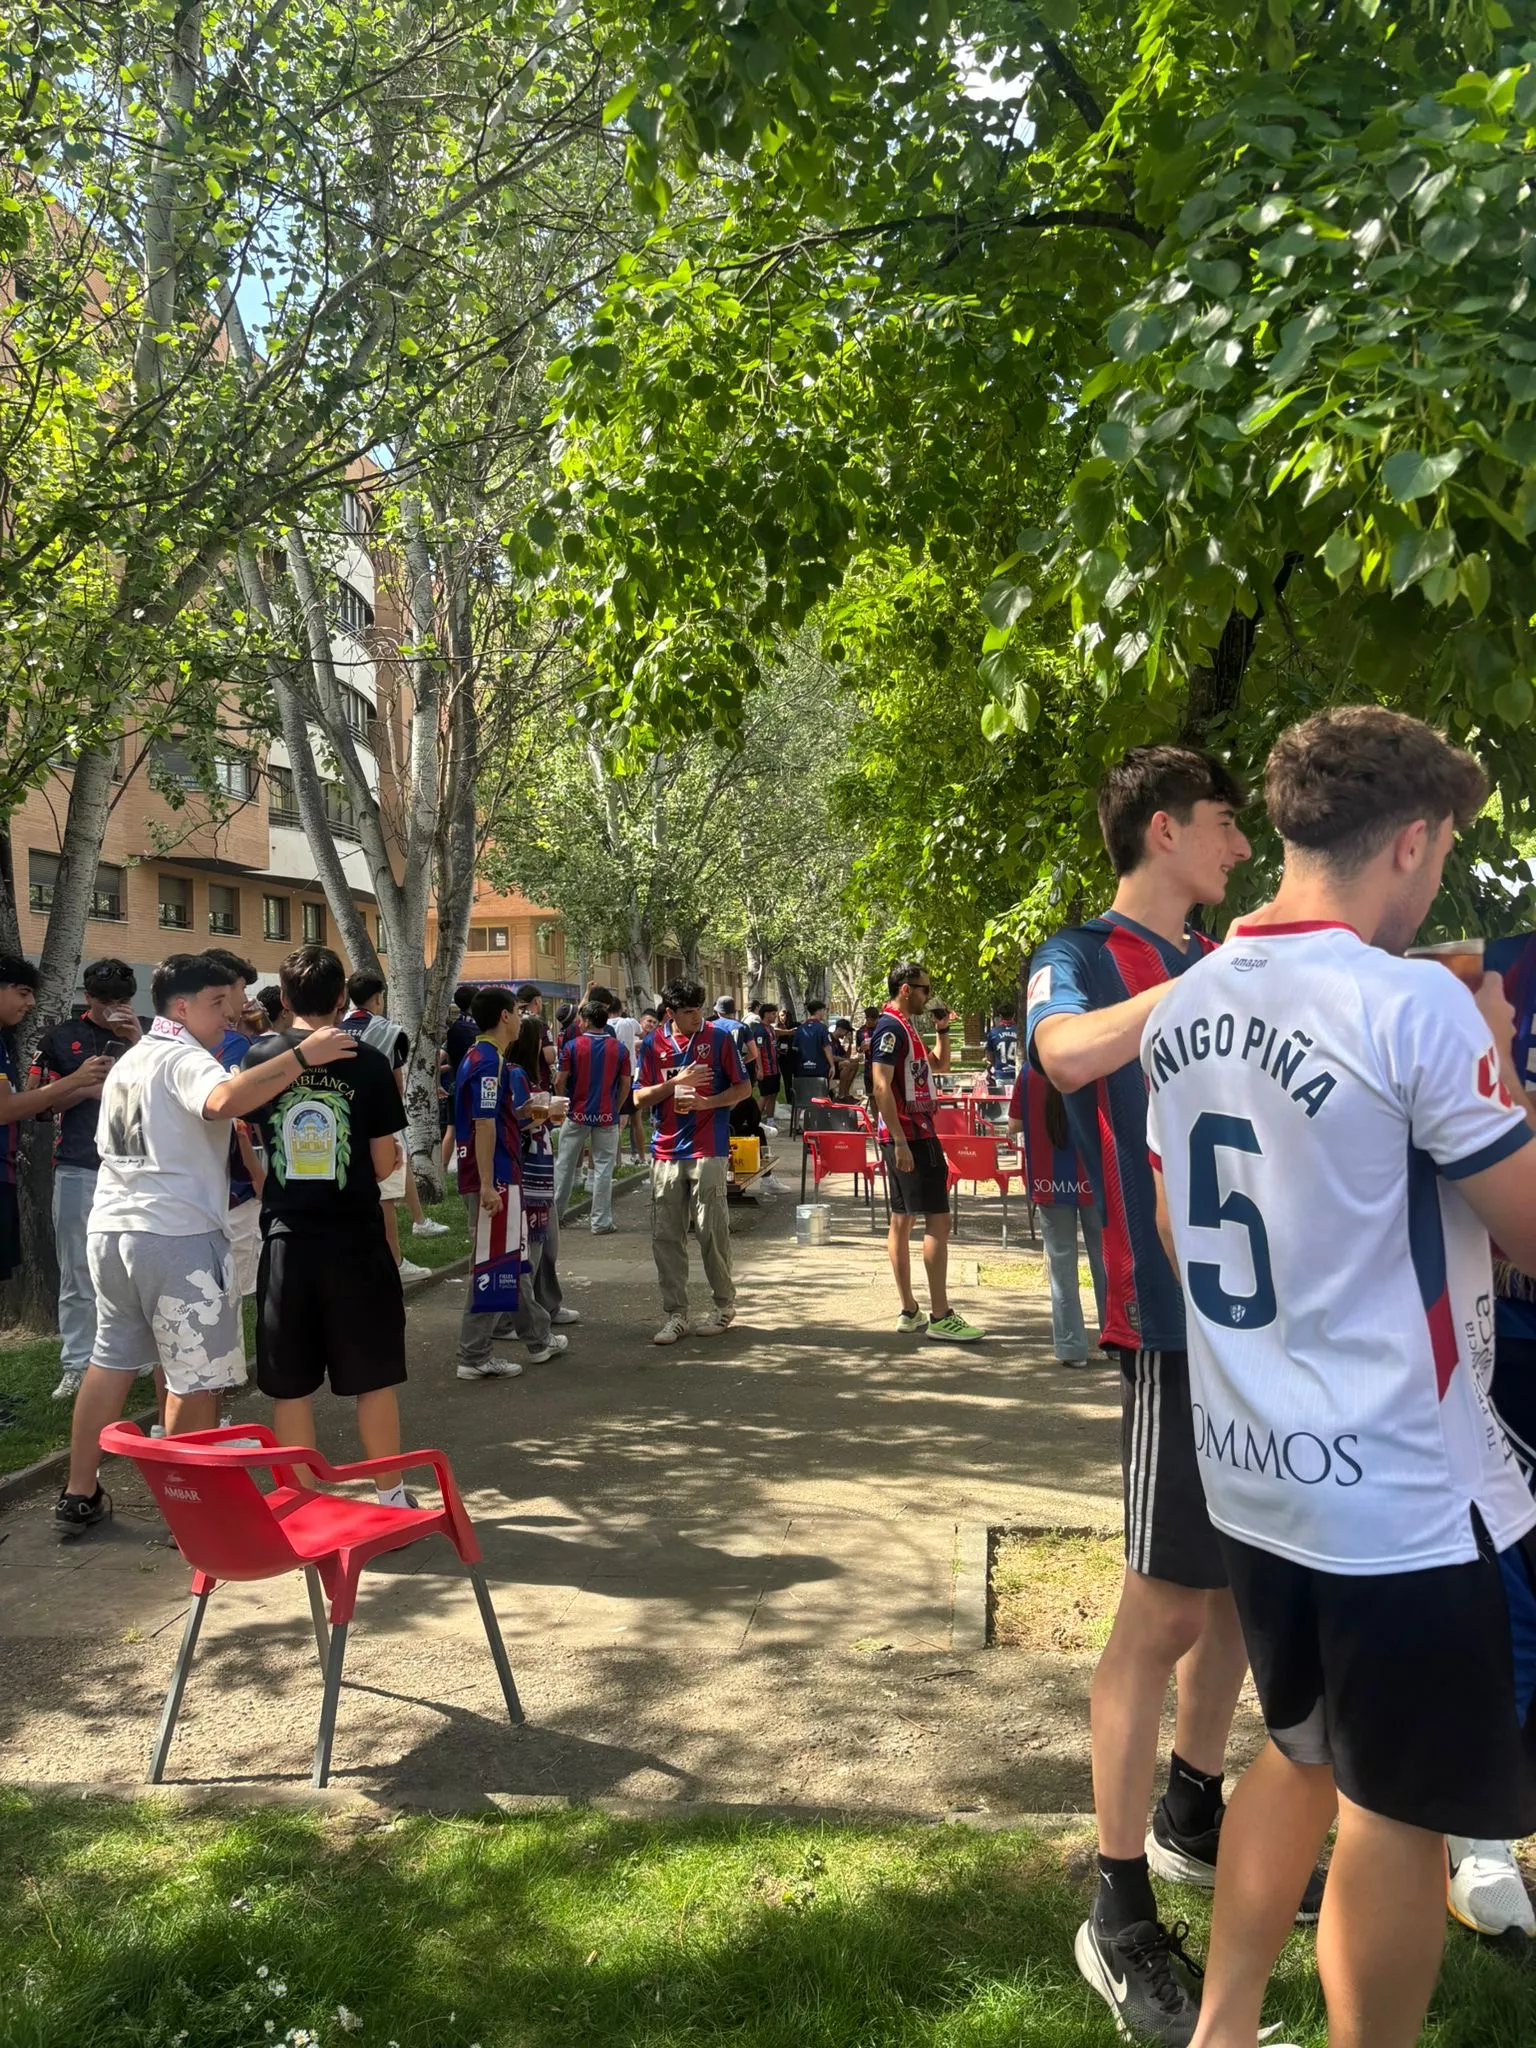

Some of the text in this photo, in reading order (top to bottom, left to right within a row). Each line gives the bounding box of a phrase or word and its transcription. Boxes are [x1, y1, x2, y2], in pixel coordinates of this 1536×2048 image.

[1230, 957, 1269, 969] amazon
[1241, 1016, 1338, 1119] PIÑA
[287, 1074, 356, 1101] ABLANCA
[482, 1091, 496, 1099] LFP
[572, 1111, 614, 1123] SOMMOS
[1187, 1112, 1277, 1330] 5
